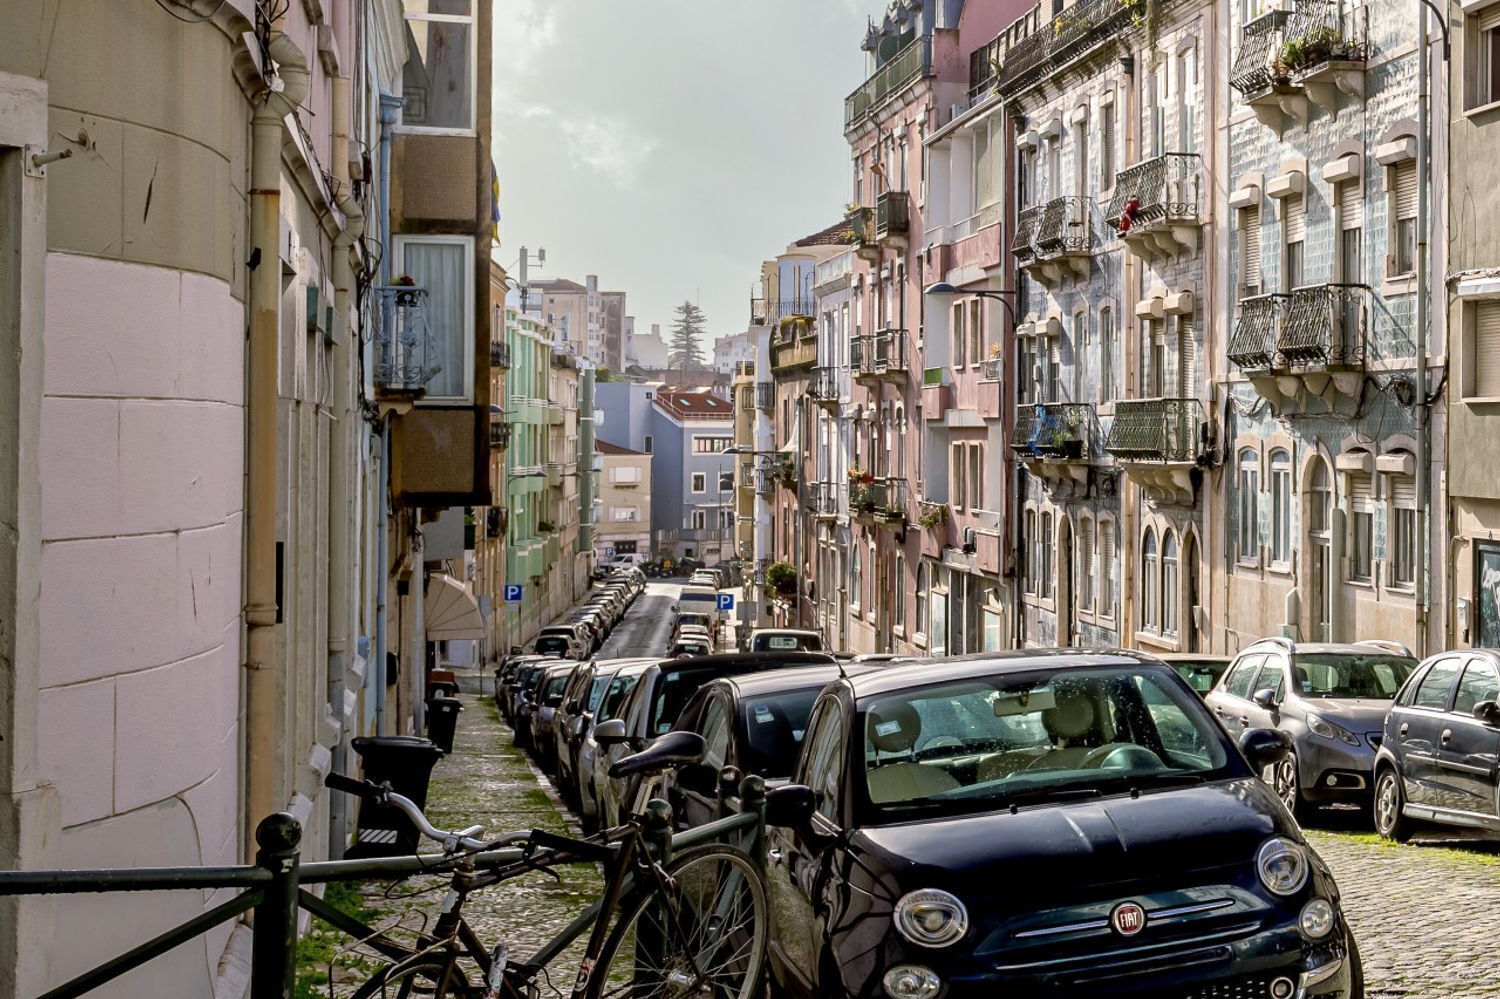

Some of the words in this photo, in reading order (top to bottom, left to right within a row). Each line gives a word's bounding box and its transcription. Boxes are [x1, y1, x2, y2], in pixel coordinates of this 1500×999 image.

[507, 586, 519, 600] P
[720, 595, 731, 608] P
[1120, 911, 1138, 928] FIAT
